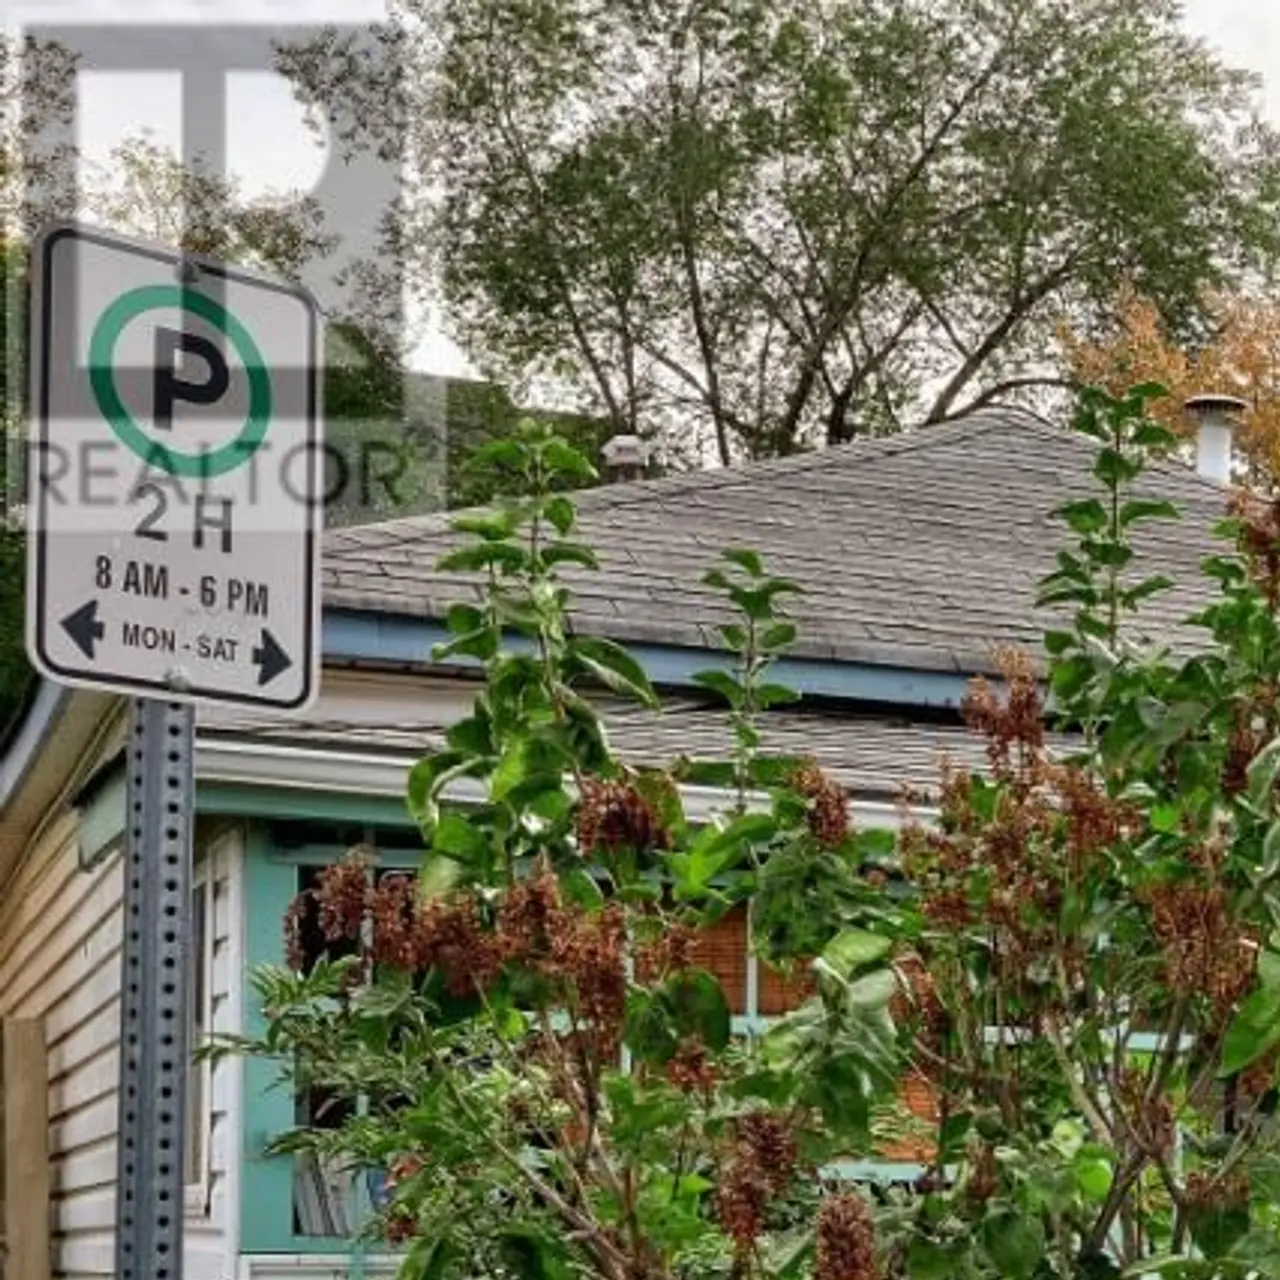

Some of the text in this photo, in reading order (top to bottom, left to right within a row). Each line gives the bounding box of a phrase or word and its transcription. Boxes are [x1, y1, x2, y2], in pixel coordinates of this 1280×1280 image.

[154, 326, 229, 431] P
[133, 484, 233, 553] 2 H
[96, 555, 112, 589] 8
[122, 560, 169, 600] AM
[199, 575, 217, 608] 6
[227, 578, 269, 619] PM
